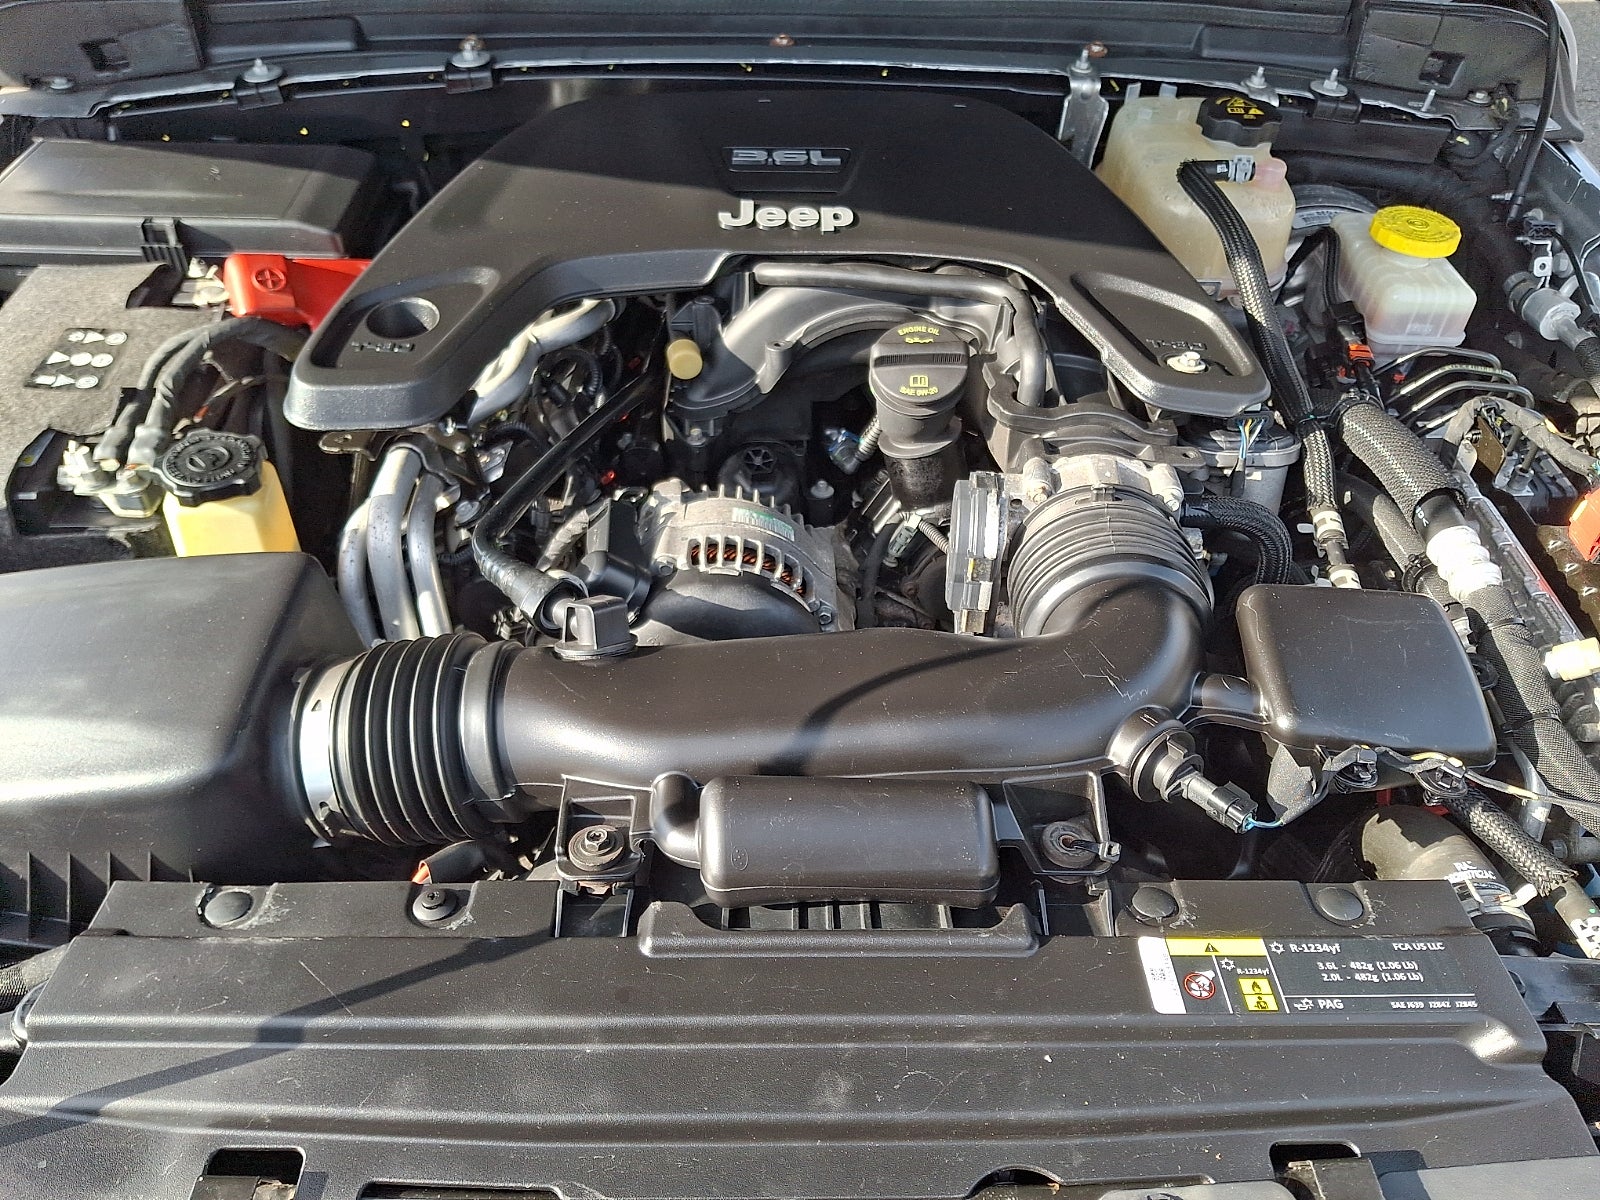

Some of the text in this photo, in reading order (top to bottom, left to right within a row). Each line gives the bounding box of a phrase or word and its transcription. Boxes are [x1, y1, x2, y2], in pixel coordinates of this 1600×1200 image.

[732, 149, 841, 166] 3.6L
[718, 199, 854, 235] Jeep
[898, 326, 940, 336] ENGINE OIL
[899, 386, 938, 397] SAE 0W-20
[1289, 942, 1342, 954] R-1234yf
[1392, 942, 1445, 951] FCA US LLC
[1316, 961, 1339, 971] 3.6L
[1350, 961, 1375, 971] 482g
[1321, 972, 1344, 982] 2.0L
[1354, 972, 1379, 983] 482g
[1318, 998, 1344, 1010] PAG
[1390, 1001, 1407, 1009] SAE
